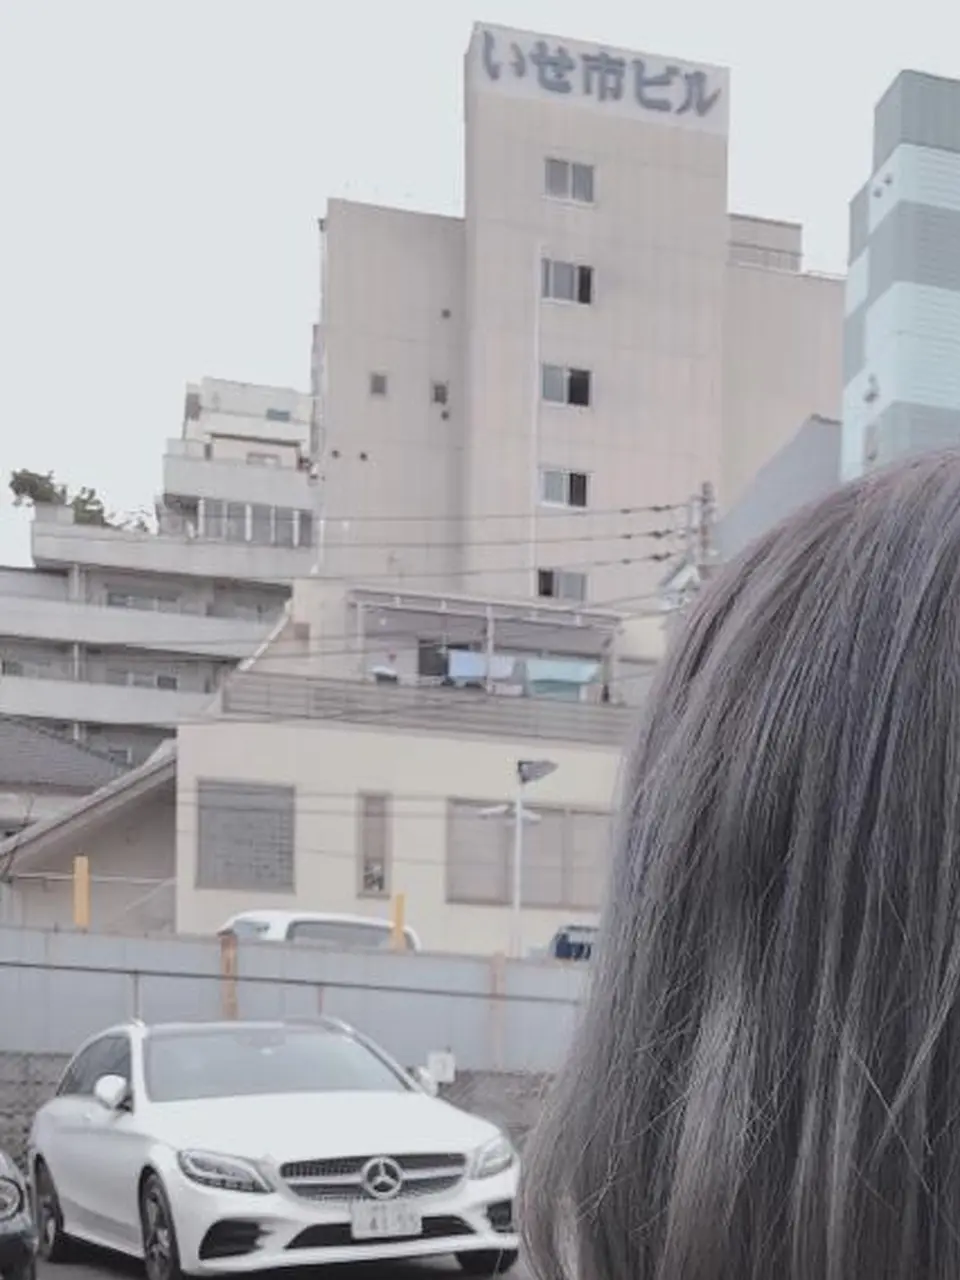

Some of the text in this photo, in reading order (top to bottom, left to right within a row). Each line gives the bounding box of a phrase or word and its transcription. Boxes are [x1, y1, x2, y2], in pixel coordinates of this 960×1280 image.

[482, 30, 722, 117] いせ市ビル
